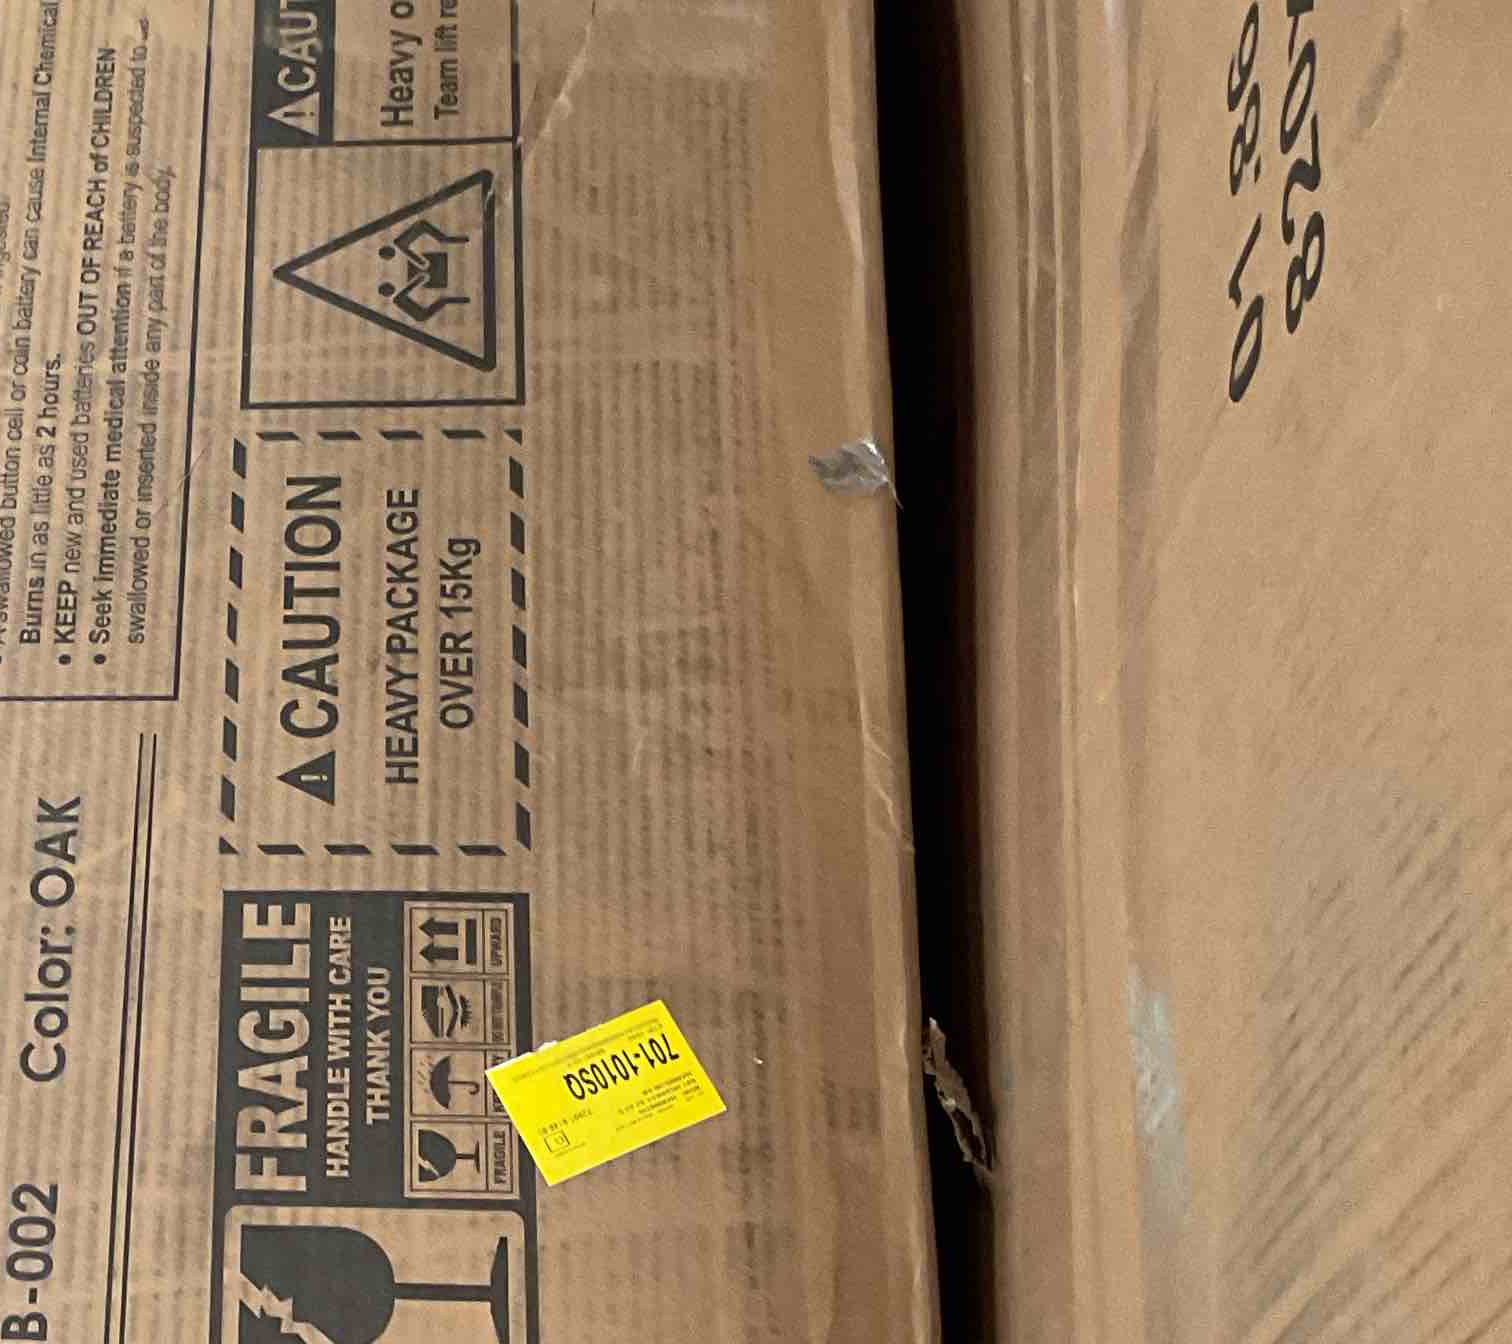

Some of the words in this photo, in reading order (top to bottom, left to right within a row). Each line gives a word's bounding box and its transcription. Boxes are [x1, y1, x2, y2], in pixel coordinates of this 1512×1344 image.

[32, 0, 59, 86] Chemical
[129, 45, 148, 64] to
[433, 24, 458, 53] lift
[91, 47, 116, 149] CHILDREN
[379, 29, 423, 128] Heavy
[433, 58, 459, 121] Team
[26, 90, 50, 162] Internal
[124, 68, 148, 157] suspected
[89, 153, 109, 173] of
[23, 168, 45, 223] cause
[82, 179, 107, 251] REACH
[118, 182, 143, 245] battery
[21, 228, 40, 261] can
[118, 251, 135, 262] a
[148, 219, 169, 248] the
[148, 252, 167, 271] of
[11, 265, 40, 331] battery
[79, 256, 101, 285] OF
[113, 267, 132, 278] if
[147, 275, 168, 313] part
[76, 291, 99, 336] OUT
[109, 284, 133, 374] attention
[144, 318, 168, 353] any
[10, 337, 31, 376] coin
[37, 352, 62, 419] hours.
[70, 336, 97, 424] batteries
[140, 359, 163, 417] inside
[9, 380, 26, 401] or
[104, 379, 128, 463] medical
[5, 408, 25, 441] cell
[36, 425, 56, 438] 2
[37, 445, 55, 468] as
[69, 432, 90, 481] used
[137, 423, 158, 502] inserted
[29, 475, 53, 515] little
[66, 488, 86, 526] and
[92, 469, 121, 583] immediate
[135, 508, 152, 529] or
[27, 552, 45, 571] in
[32, 521, 50, 547] as
[62, 531, 82, 573] new
[125, 536, 151, 645] swallowed
[385, 488, 419, 655] PACKAGE
[438, 538, 481, 620] 15Kg
[18, 577, 45, 645] Burns
[53, 579, 79, 645] KEEP
[88, 588, 113, 645] Seek
[278, 475, 342, 739] CAUTION
[438, 631, 473, 730] OVER
[384, 665, 419, 785] HEAVY
[28, 795, 81, 909] OAK
[328, 916, 352, 986] CARE
[18, 925, 76, 1084] Color:
[366, 966, 391, 1021] YOU
[233, 902, 311, 1193] FRAGILE
[327, 993, 351, 1061] WITH
[365, 1029, 391, 1126] THANK
[562, 1032, 681, 1100] 701-1010SQ
[325, 1067, 350, 1178] HANDLE
[493, 1130, 506, 1185] FRAGILE
